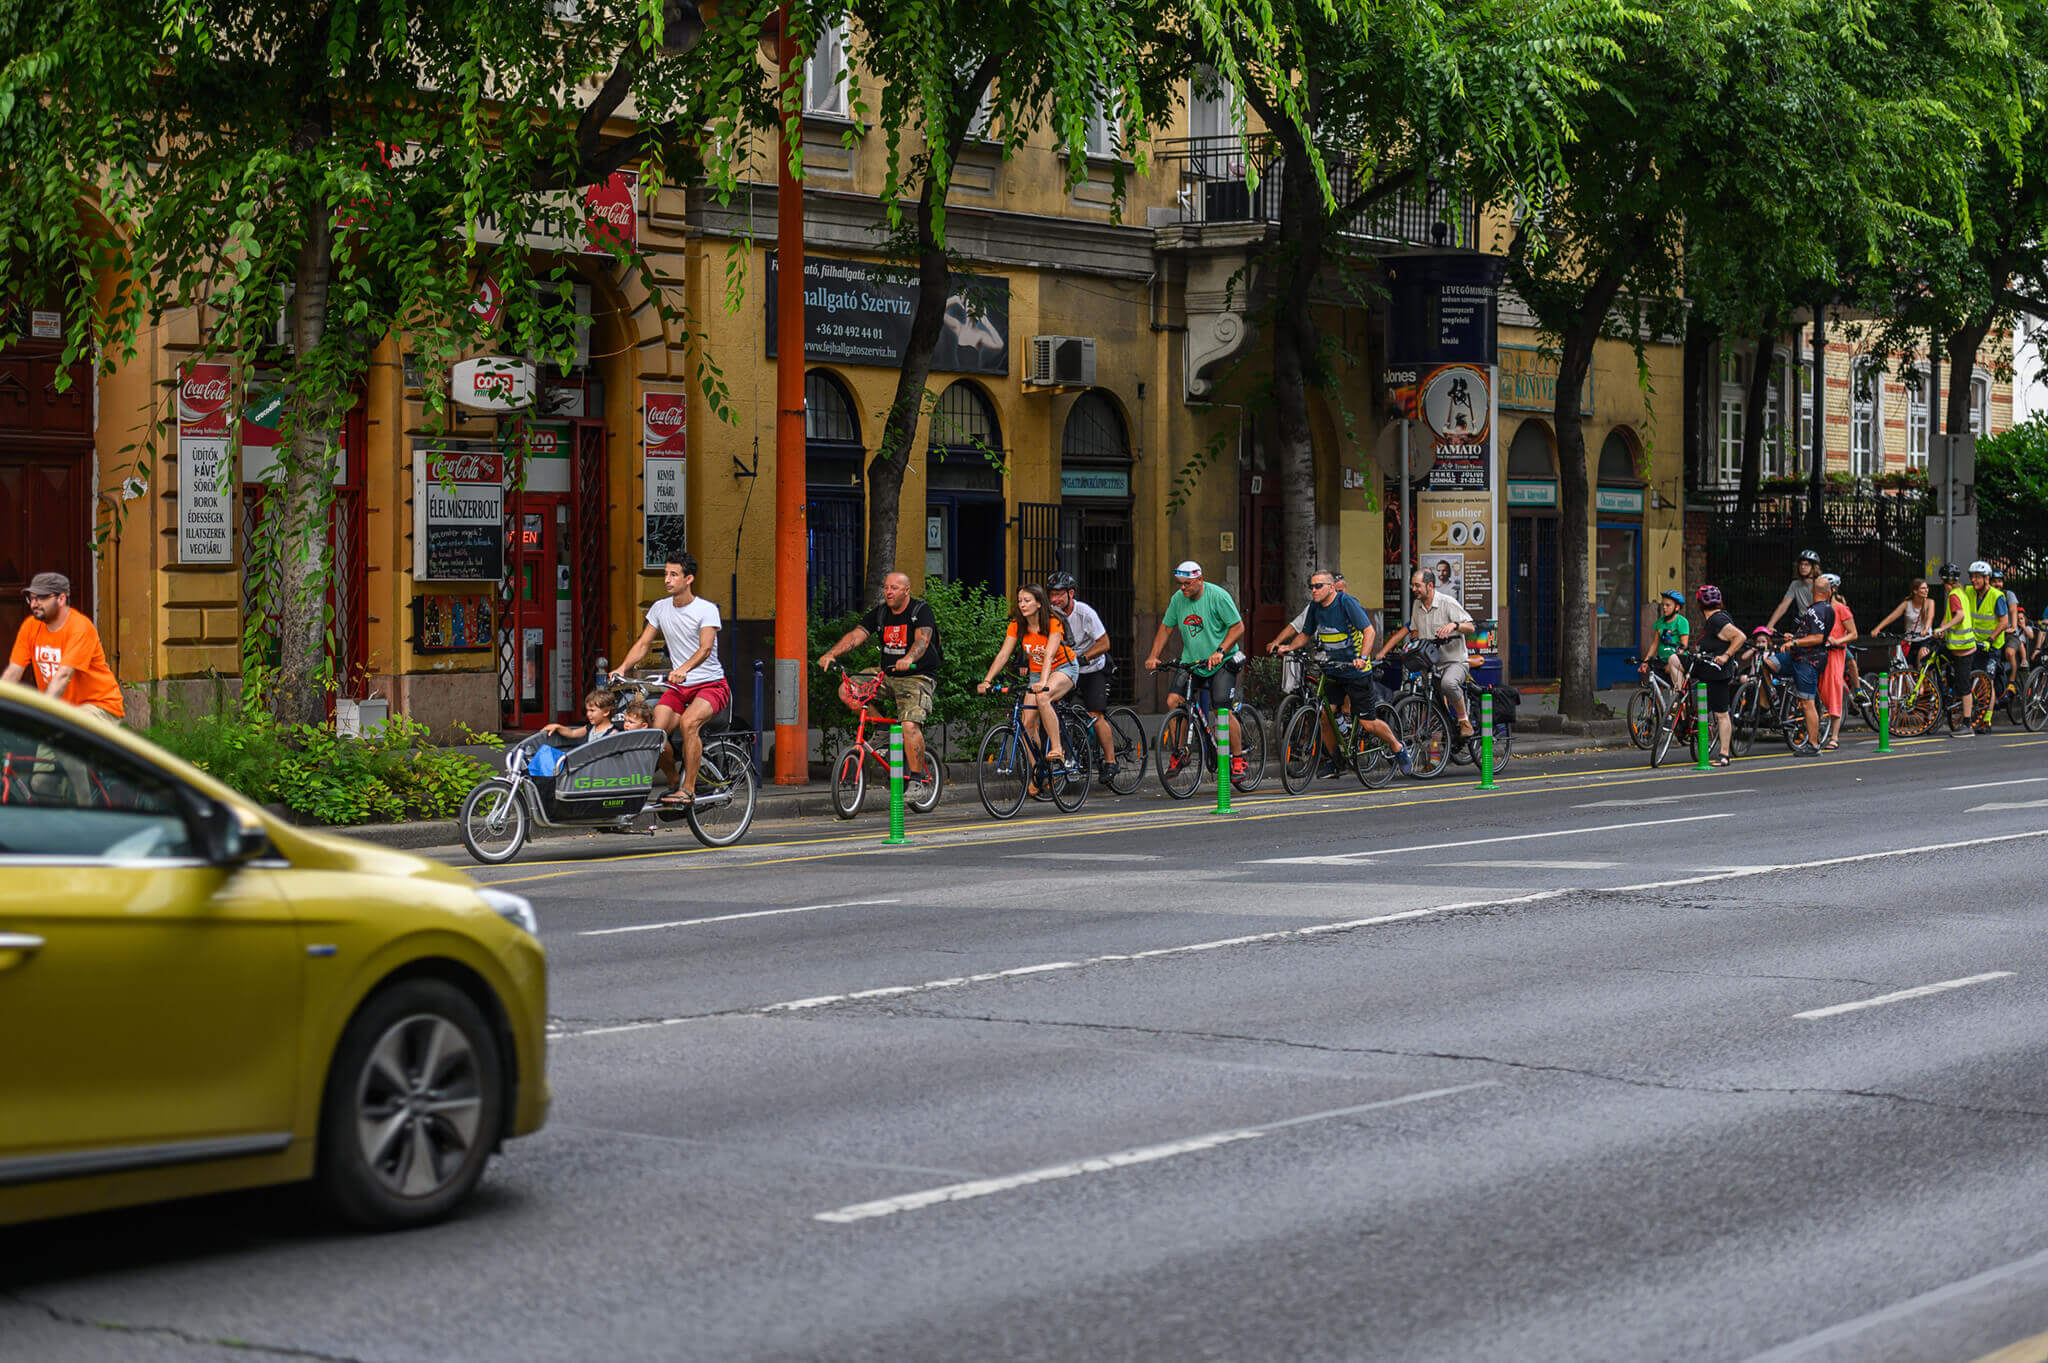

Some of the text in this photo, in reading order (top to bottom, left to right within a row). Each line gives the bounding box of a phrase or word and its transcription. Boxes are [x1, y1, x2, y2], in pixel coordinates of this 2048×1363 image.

[861, 291, 911, 315] Szerviz
[816, 323, 883, 340] +36 20 492 44 01
[183, 377, 228, 400] Coca-Cola
[648, 406, 683, 426] Coca-Cola
[192, 447, 219, 461] ÜDÍTŐK
[1436, 444, 1482, 455] YAMATO
[657, 466, 676, 481] KENYÉR
[193, 496, 218, 508] BOROK
[429, 494, 499, 519] ÉLELMISZERBOLT
[187, 509, 225, 524] ÉDESSÉGEK
[185, 527, 226, 539] ILLATSZEREK
[1430, 520, 1487, 547] 200
[574, 773, 653, 789] Gazelle
